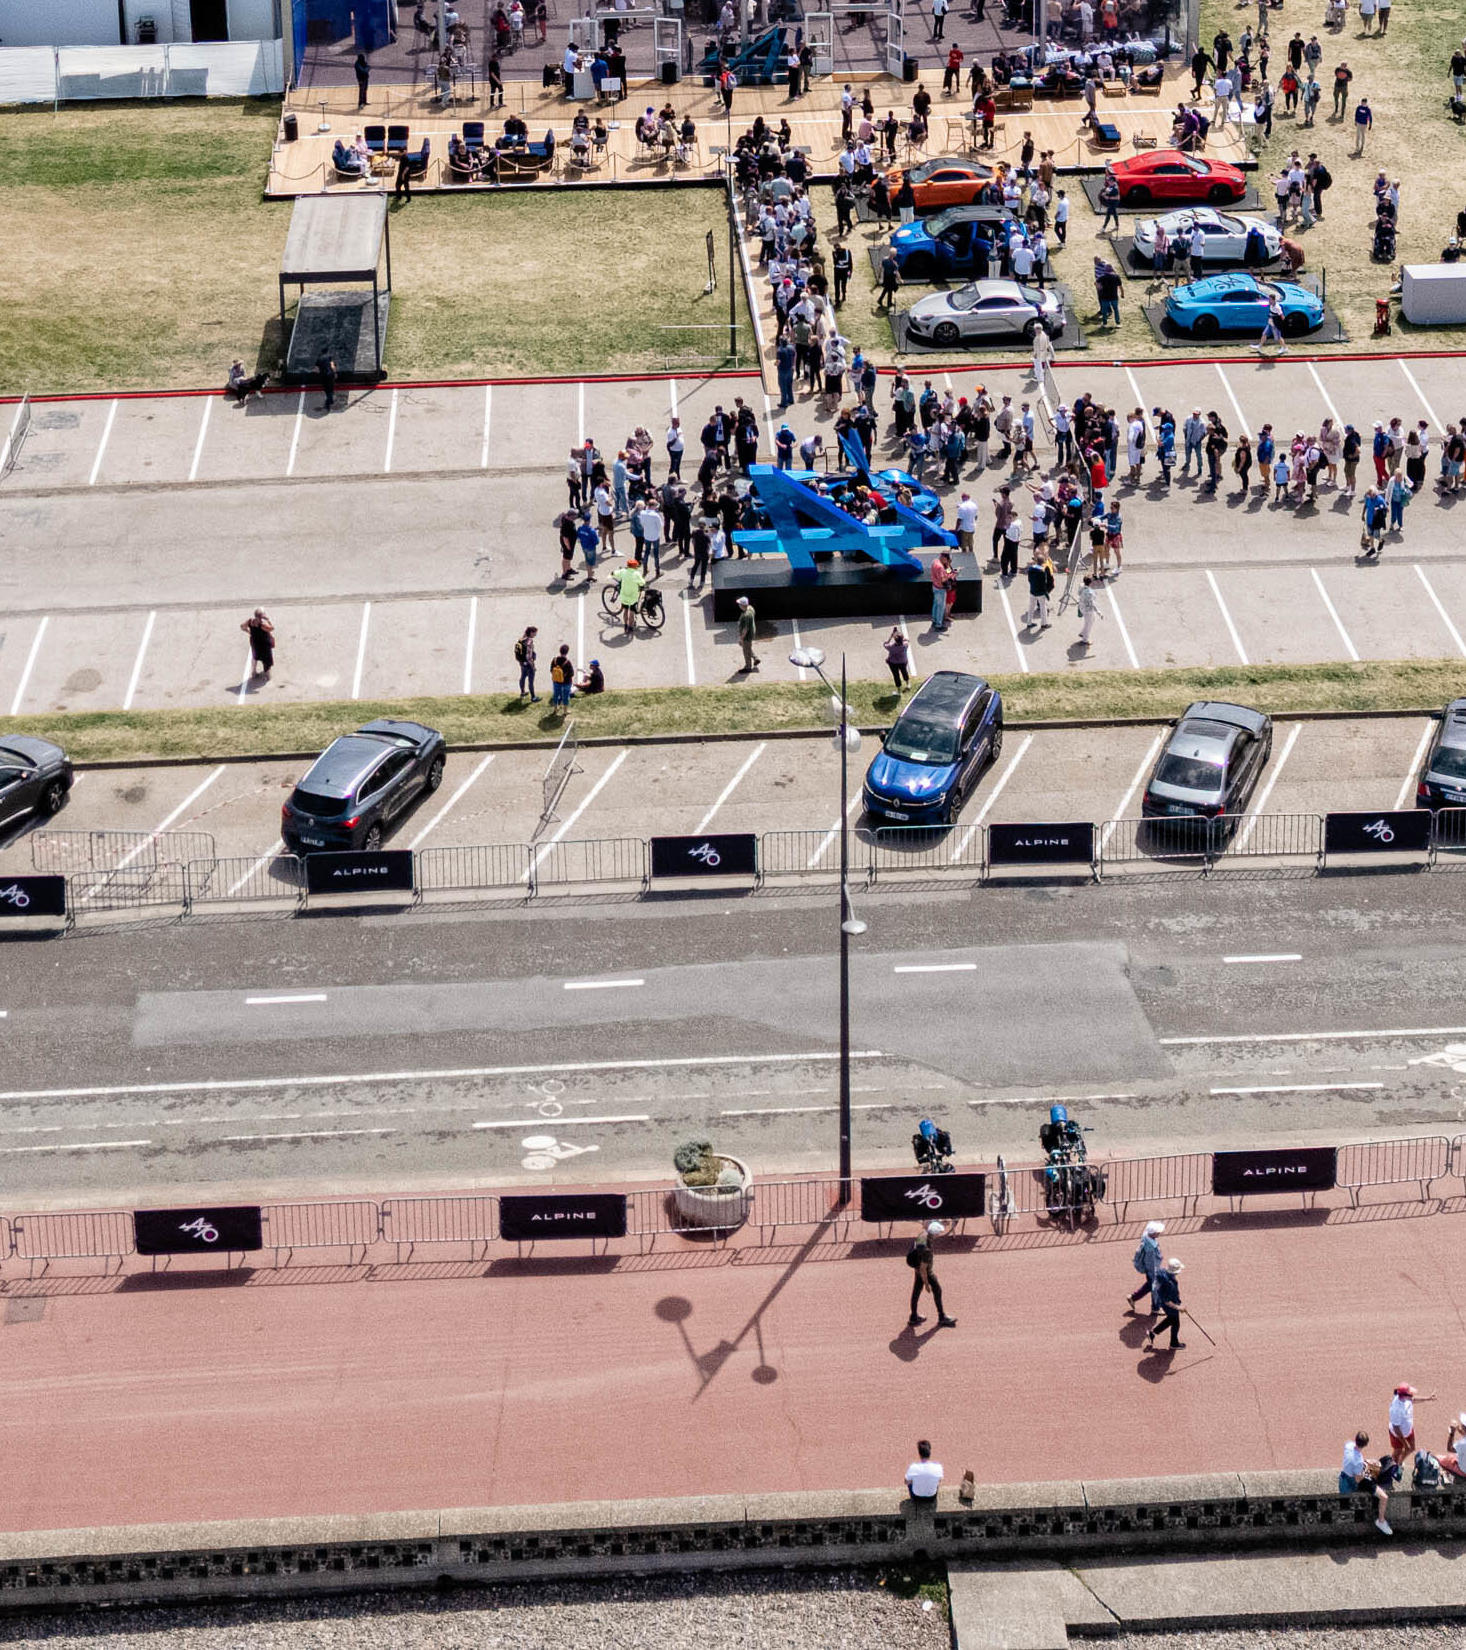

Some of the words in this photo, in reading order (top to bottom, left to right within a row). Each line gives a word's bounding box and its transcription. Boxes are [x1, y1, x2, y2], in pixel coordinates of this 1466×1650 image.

[1015, 838, 1069, 846] ALPINE
[333, 867, 389, 876] ALPINE
[1243, 1166, 1307, 1175] ALPINE
[532, 1212, 596, 1221] ALPINE
